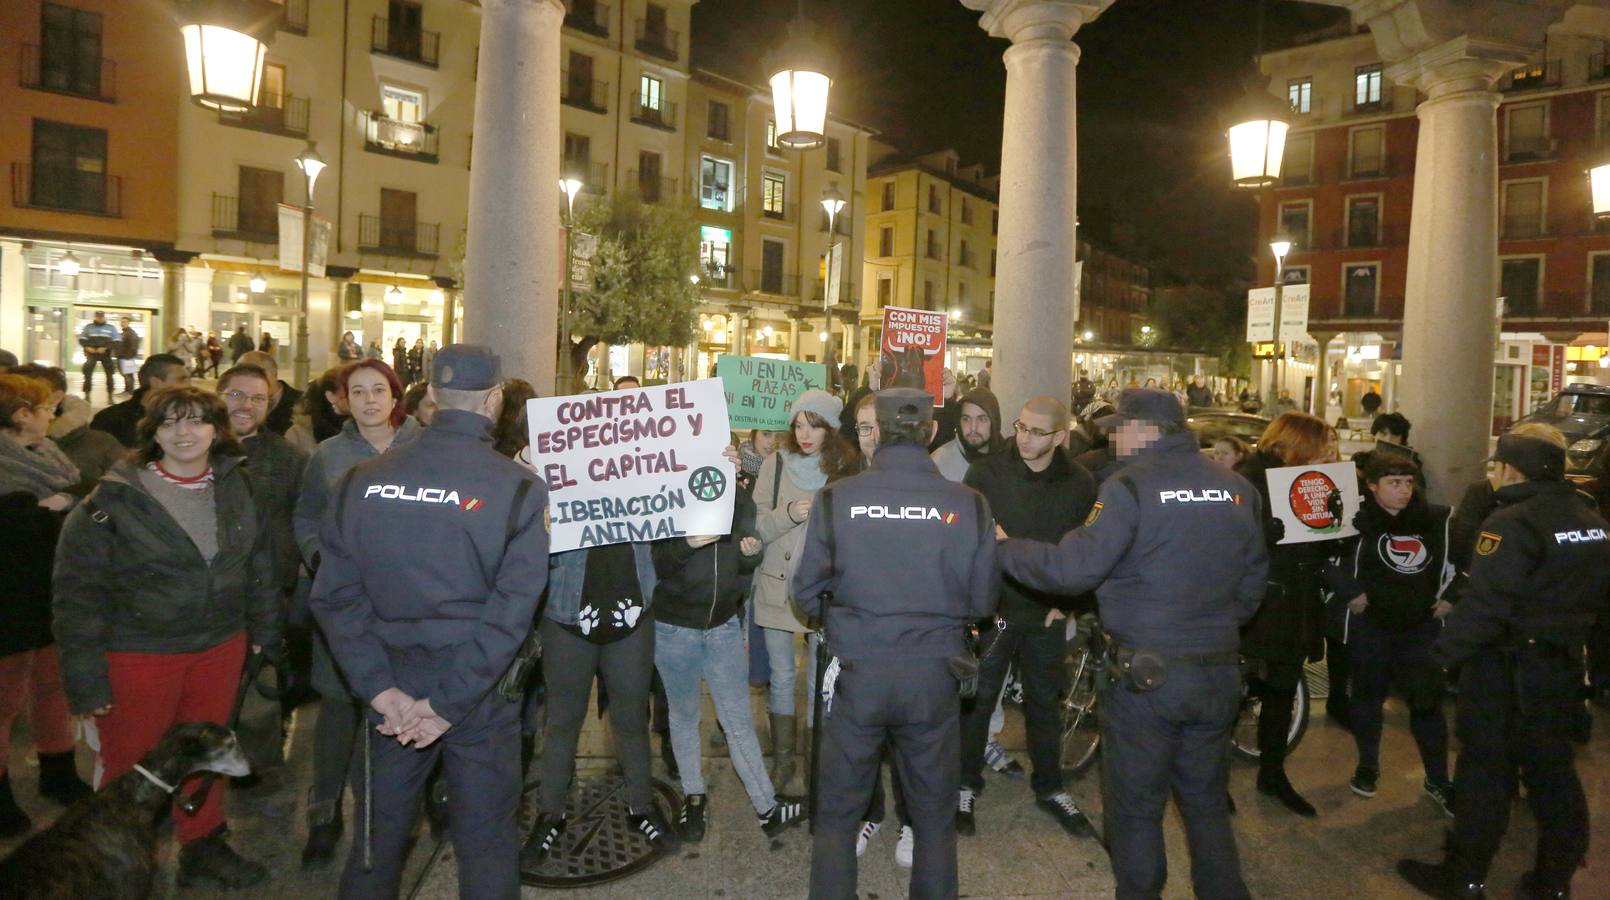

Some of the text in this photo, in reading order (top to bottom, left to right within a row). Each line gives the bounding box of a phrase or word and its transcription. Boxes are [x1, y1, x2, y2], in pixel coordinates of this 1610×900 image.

[889, 311, 941, 325] CON MIS
[888, 321, 941, 334] IMPUESTOS
[739, 360, 805, 382] NI EN LAS
[752, 378, 797, 396] PLAZAS
[557, 387, 695, 425] CONTRA EL
[741, 395, 756, 408] EN
[761, 396, 777, 409] TU
[687, 412, 704, 437] Y
[544, 463, 578, 492] EL
[1300, 478, 1325, 487] TENGO
[1297, 484, 1330, 494] DERECHO
[1311, 492, 1328, 500] UNA
[1307, 499, 1326, 507] VIDA
[1302, 511, 1334, 521] TORTURA
[579, 516, 687, 547] ANIMAL
